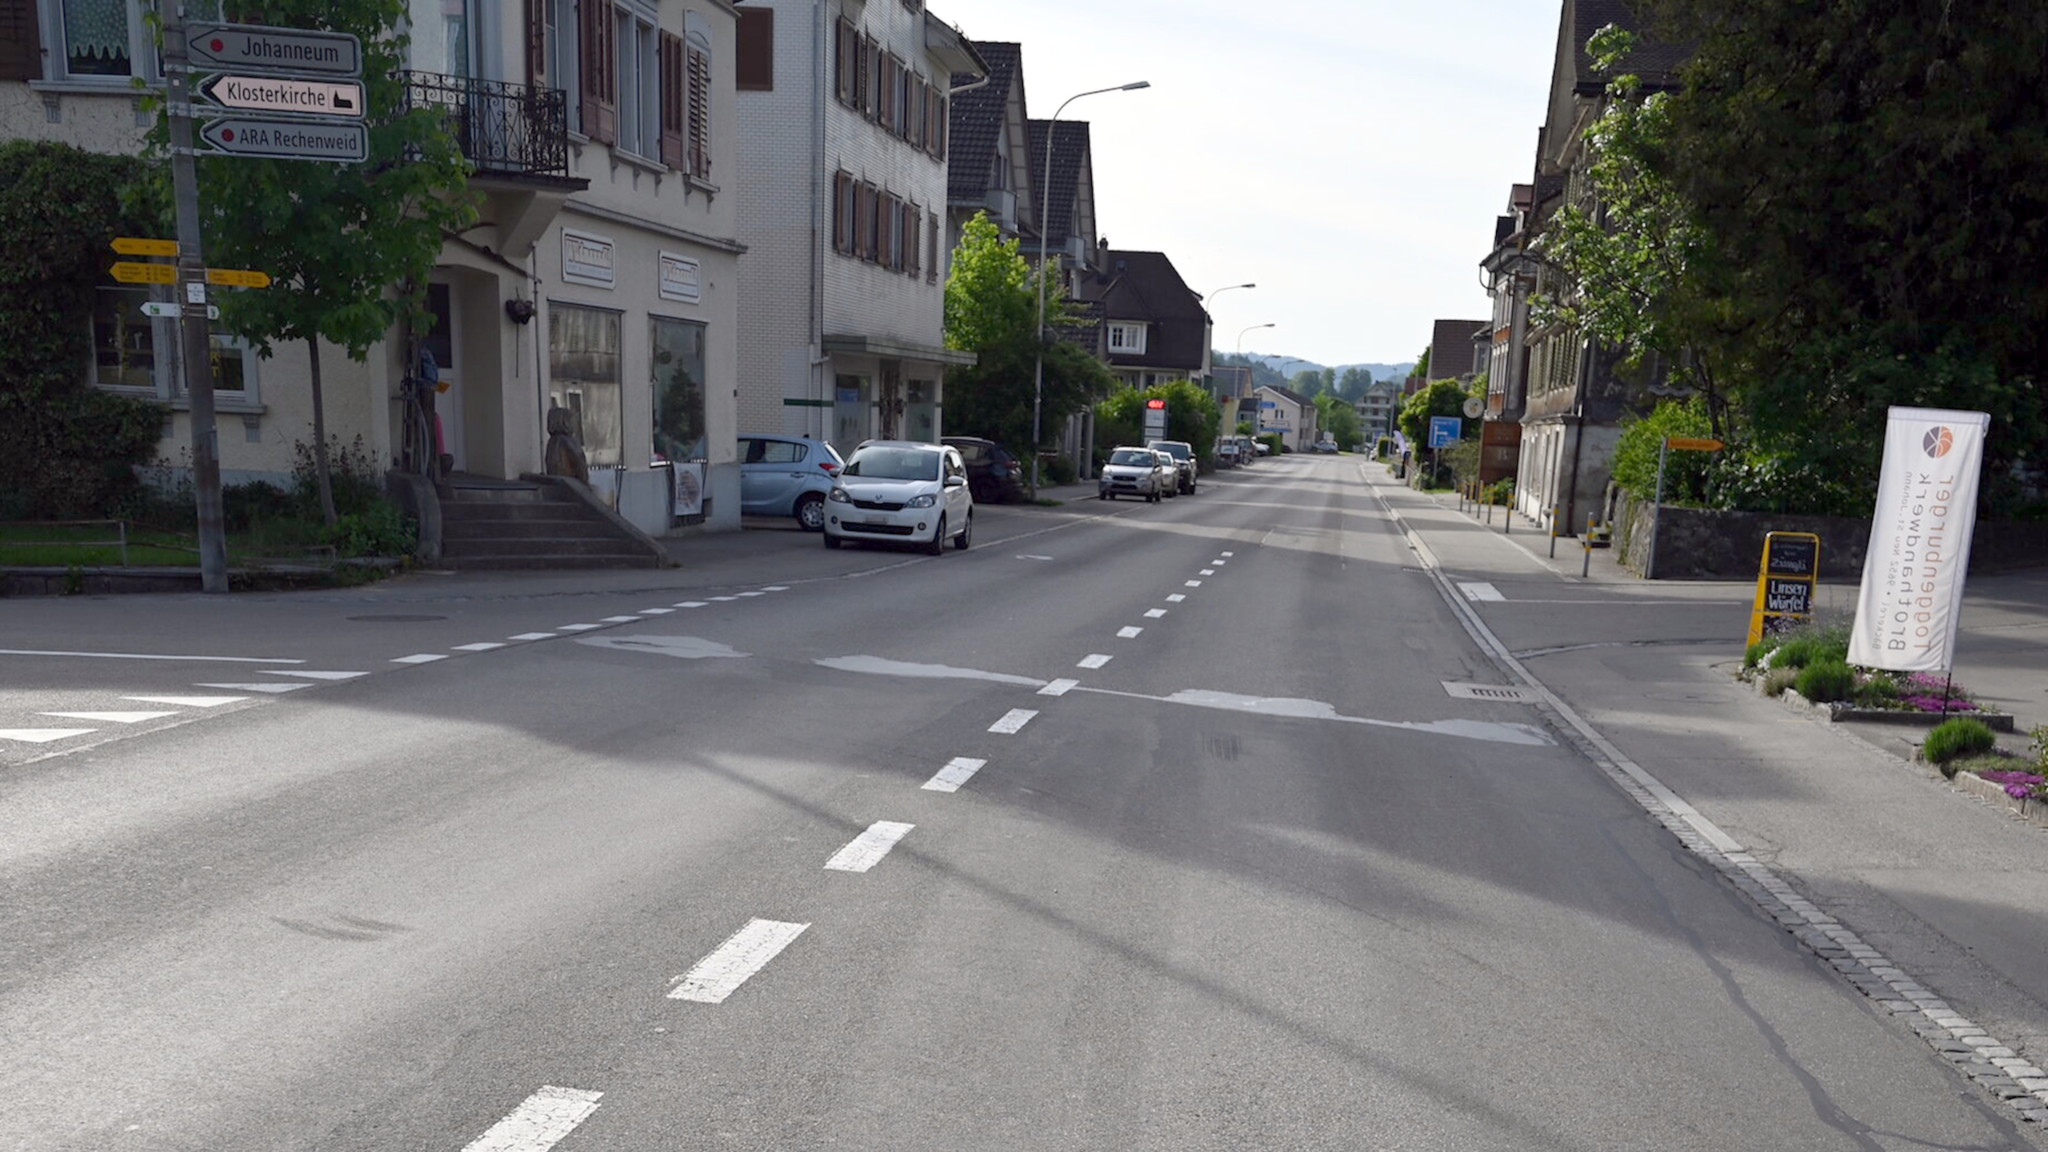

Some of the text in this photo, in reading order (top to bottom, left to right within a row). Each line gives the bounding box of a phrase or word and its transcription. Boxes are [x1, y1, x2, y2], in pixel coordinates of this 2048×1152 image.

[241, 37, 339, 63] Johanneum
[227, 82, 326, 106] Klosterkirche
[240, 128, 357, 151] ARA Rechenweid
